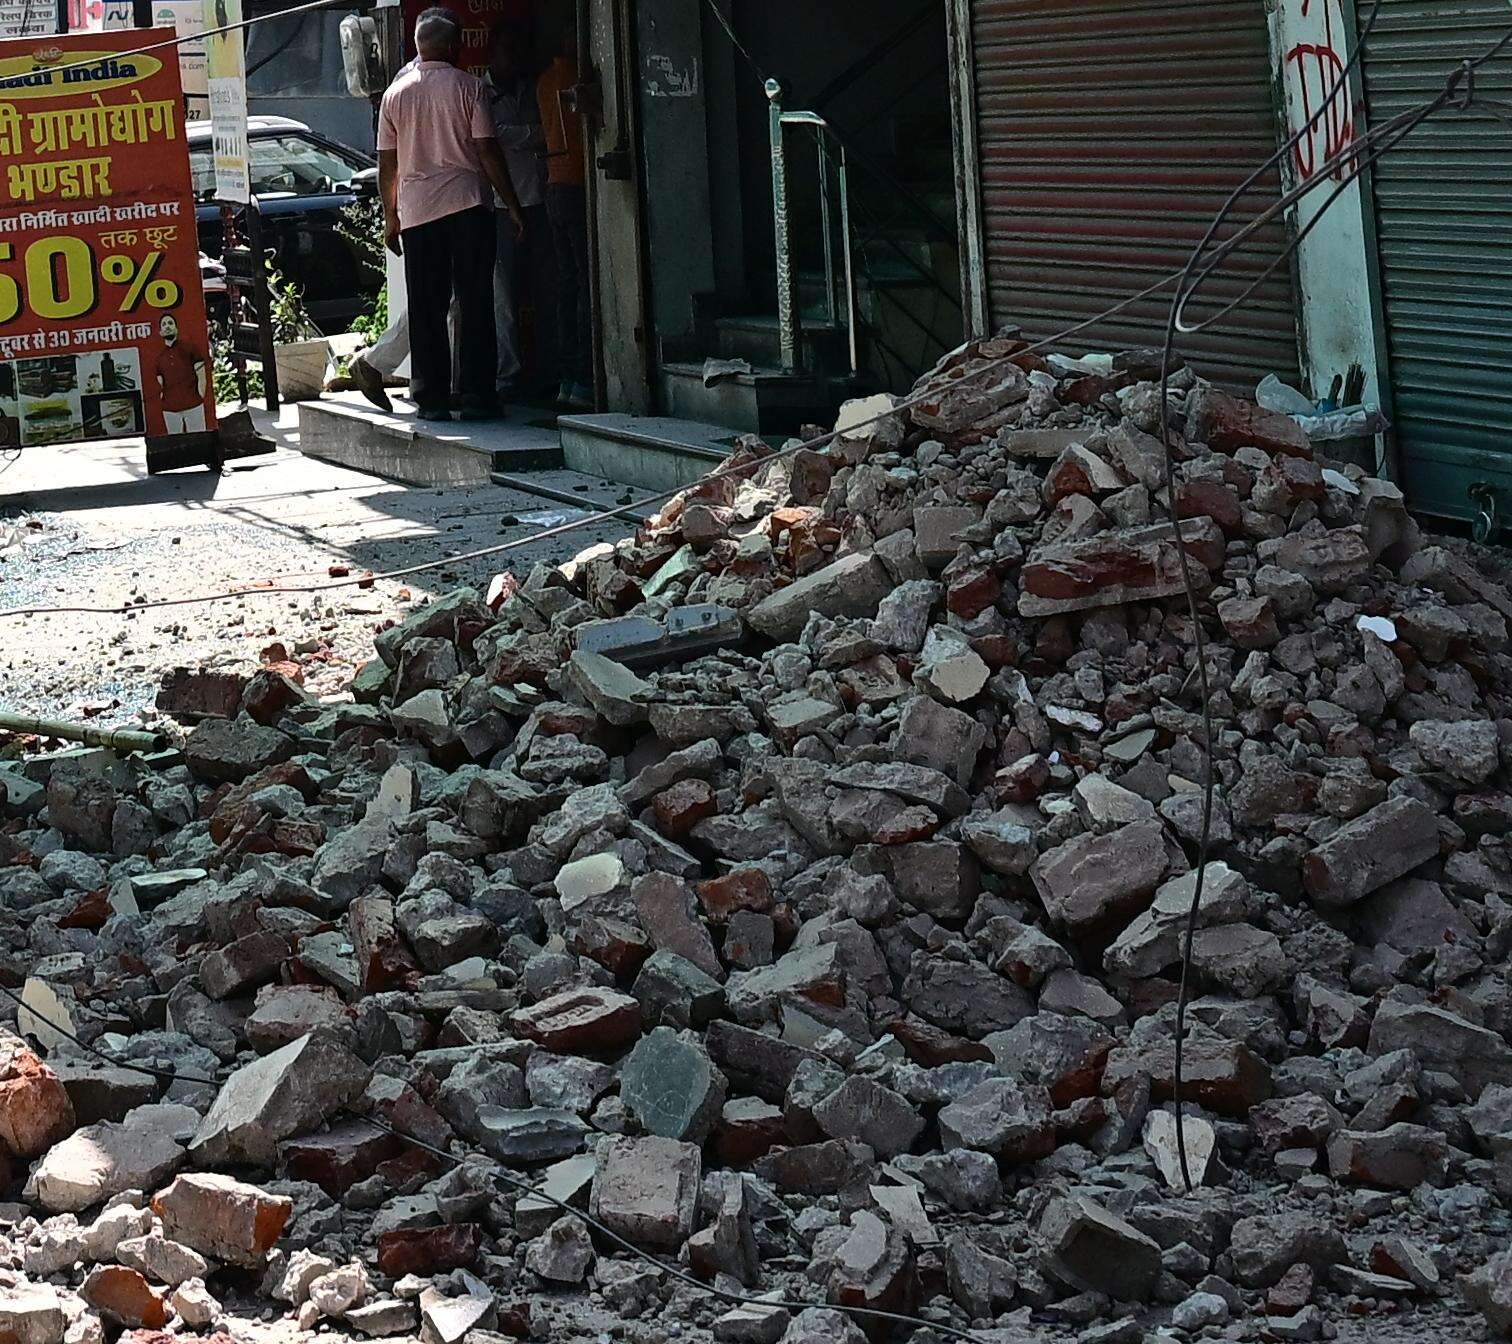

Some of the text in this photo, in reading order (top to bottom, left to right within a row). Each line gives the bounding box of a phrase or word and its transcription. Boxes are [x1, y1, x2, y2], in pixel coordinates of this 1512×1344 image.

[62, 61, 138, 84] India
[28, 89, 176, 154] ग्रामोद्योग
[7, 156, 113, 202] भण्डार
[19, 208, 69, 231] निर्मित
[71, 206, 112, 226] खादी
[114, 203, 159, 223] खरीद
[160, 201, 180, 218] पर
[98, 225, 179, 251] तक छूट
[34, 328, 47, 351] से
[48, 328, 71, 349] 30
[72, 322, 124, 347] जनवरी
[126, 321, 152, 339] तक
